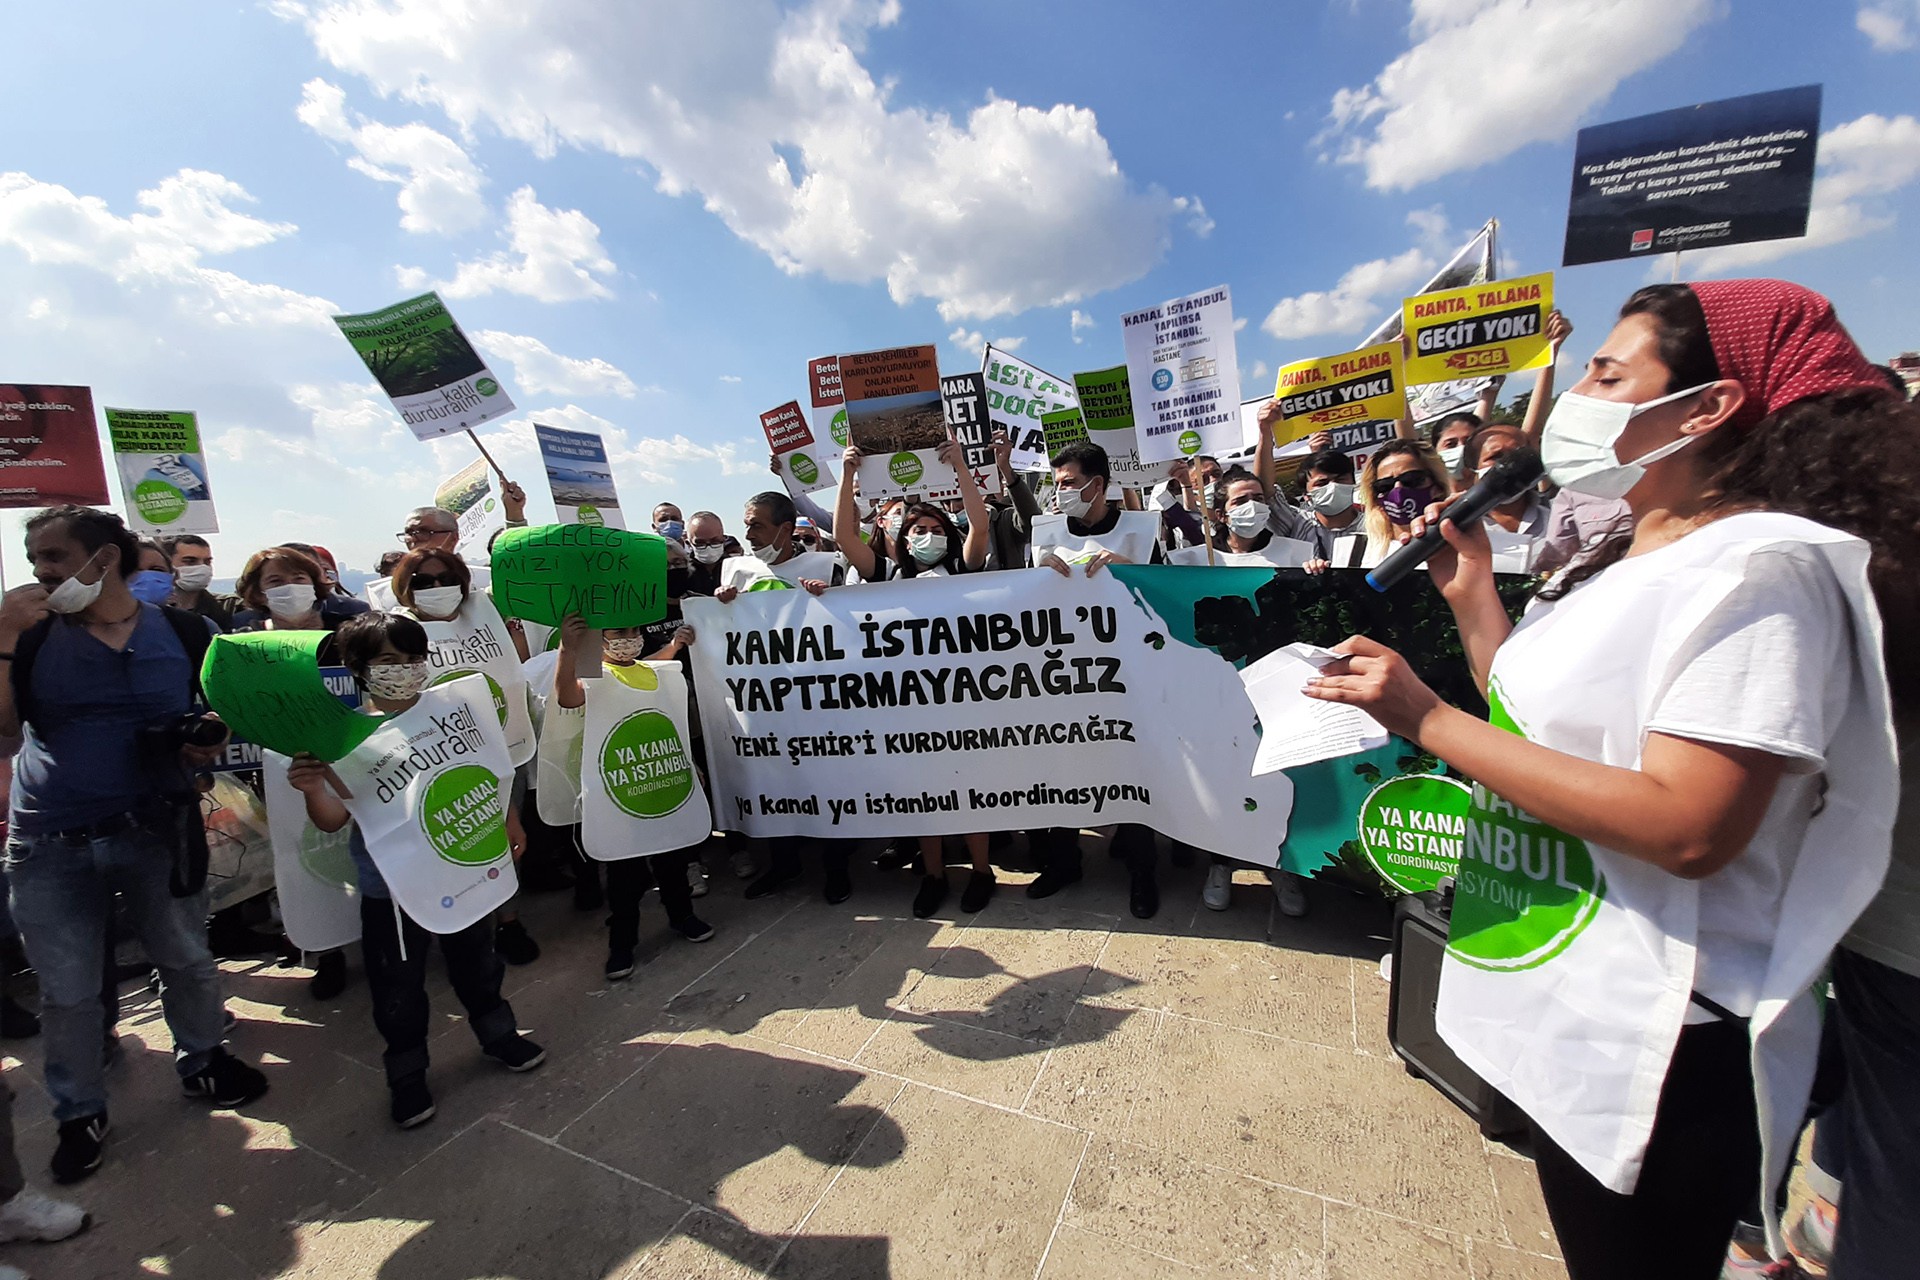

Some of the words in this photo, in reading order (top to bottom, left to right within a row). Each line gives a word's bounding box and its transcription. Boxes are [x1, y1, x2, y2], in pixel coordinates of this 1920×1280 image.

[1581, 164, 1604, 176] Kaz
[1605, 150, 1677, 170] dağlarından
[1678, 138, 1740, 157] karadeniz
[1740, 129, 1808, 146] derelerine,
[1590, 173, 1625, 186] kuzey
[1625, 157, 1714, 180] ormanlarından
[1637, 181, 1646, 190] a
[1647, 175, 1678, 188] karşı
[1679, 169, 1720, 186] yaşam
[1721, 160, 1783, 176] alanlarını
[1124, 309, 1164, 327] KANAL
[1167, 291, 1227, 316] İSTANBUL
[1415, 297, 1472, 318] RANTA,
[1477, 284, 1541, 308] TALANA
[1154, 312, 1201, 333] YAPILIRSA
[1418, 321, 1477, 350] GEÇİT
[1483, 313, 1537, 341] YOK!
[845, 366, 869, 378] KARIN
[870, 359, 931, 376] DOYURMUYOR!
[853, 353, 880, 365] BETON
[1153, 350, 1181, 364] HASTANE
[1281, 367, 1327, 388] RANTA,
[1331, 352, 1392, 377] TALANA
[1465, 351, 1504, 367] DGB
[440, 380, 475, 403] katıl
[864, 388, 893, 399] KANAL
[893, 385, 919, 395] DİYOR!
[865, 377, 891, 387] ONLAR
[893, 373, 915, 383] HALA
[1151, 399, 1170, 411] TAM
[1173, 389, 1222, 407] DONANIMLI
[1281, 390, 1333, 415] GEÇİT
[1339, 378, 1390, 403] YOK!
[1146, 421, 1185, 437] MAHRUM
[1187, 413, 1229, 429] KALACAK
[1159, 403, 1216, 422] HASTANEDEN
[1328, 405, 1363, 418] DGB
[957, 424, 983, 446] ALI
[1329, 425, 1372, 449] PTAL
[1375, 421, 1396, 440] ET
[967, 447, 985, 466] ET
[498, 555, 559, 575] MİZİ
[580, 551, 630, 572] YOK
[456, 624, 497, 651] katıl
[726, 625, 845, 666] KANAL
[859, 606, 1117, 658] İSTANBUL'U
[323, 676, 356, 696] RUM
[726, 649, 1127, 712] YAPTIRMAYACAĞIZ
[429, 703, 477, 737] katıl
[615, 746, 637, 765] YA
[639, 737, 682, 760] KANAL
[731, 732, 781, 757] YENİ
[787, 729, 877, 766] ŞEHİR'İ
[884, 715, 1136, 754] KURDURMAYACAĞIZ
[368, 767, 379, 776] Ya
[394, 743, 406, 753] Ya
[376, 728, 486, 804] durduralım
[607, 768, 629, 787] YA
[627, 774, 688, 797] KOORDİNASYONU
[433, 807, 457, 827] YA
[452, 779, 498, 815] KANAL
[735, 795, 753, 821] ya
[759, 794, 820, 816] kanal
[828, 799, 858, 825] ya
[865, 790, 959, 815] istanbul
[968, 783, 1151, 814] koordinasyonu
[1378, 806, 1404, 828] YA
[1409, 809, 1466, 836] KANA
[435, 830, 458, 850] YA
[1366, 827, 1391, 848] YA
[1466, 817, 1583, 893] NBUL
